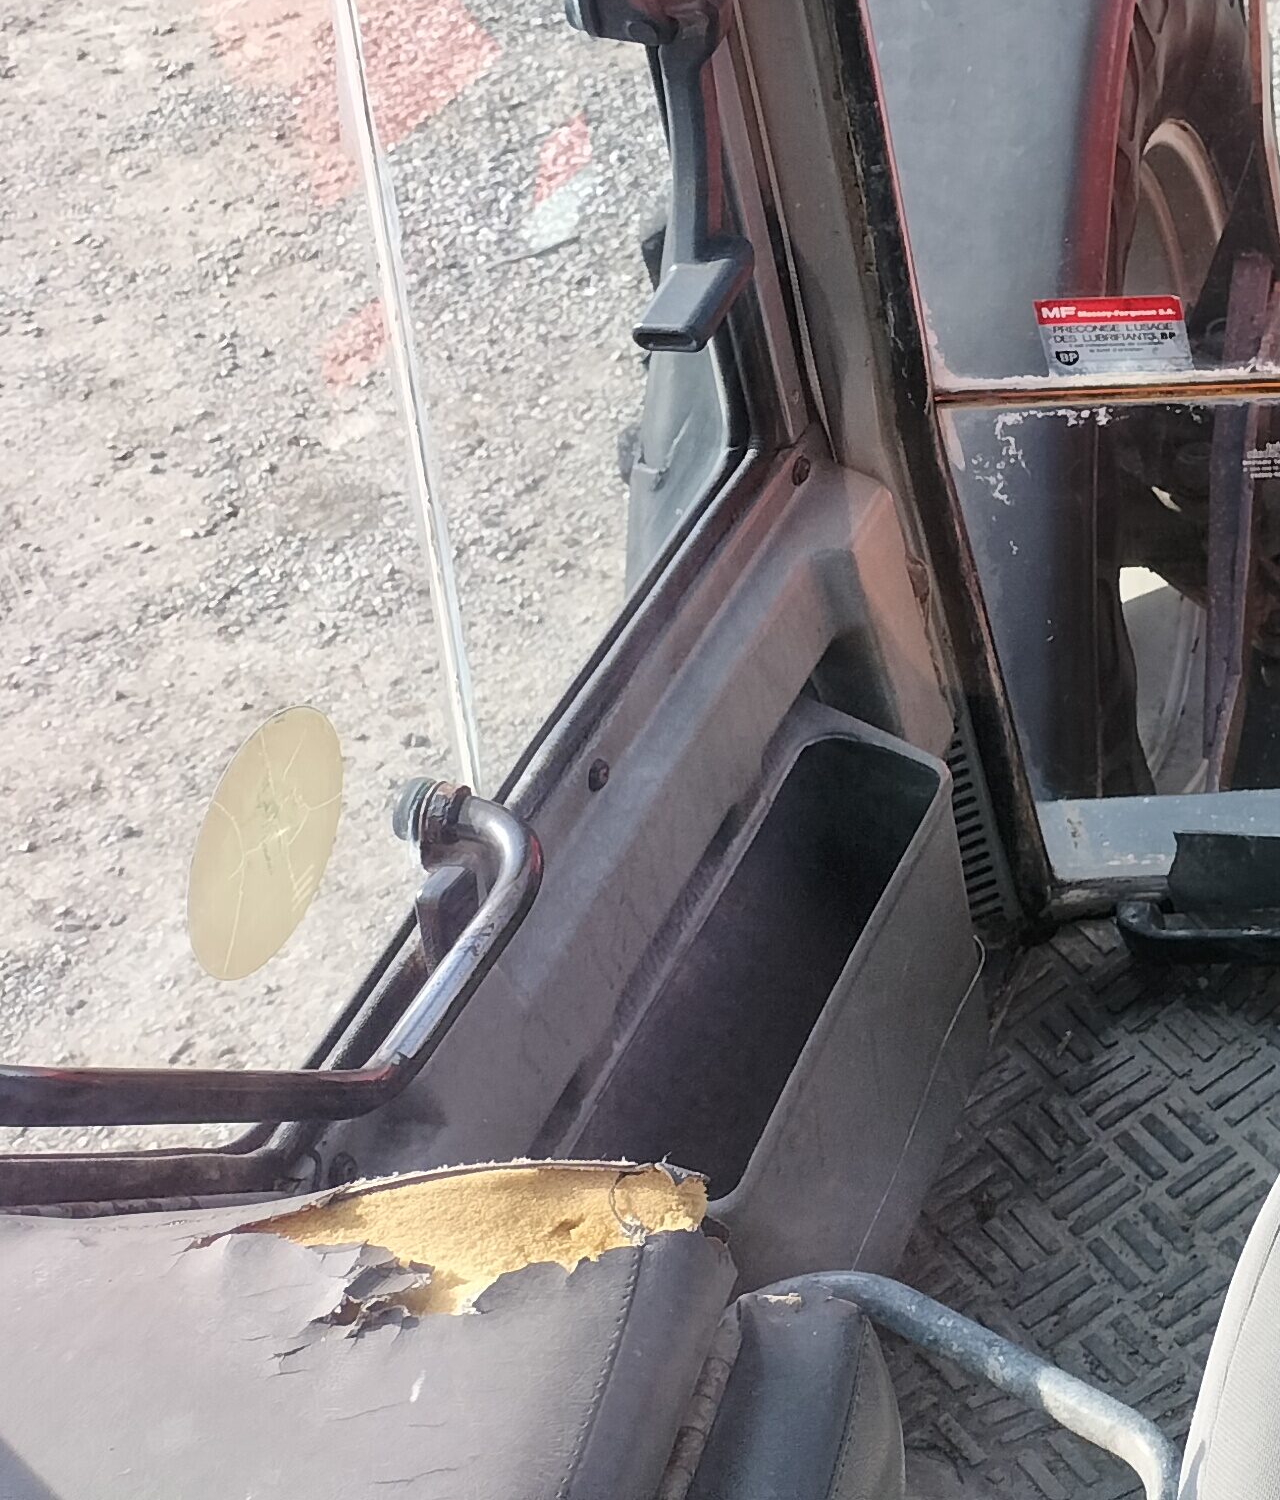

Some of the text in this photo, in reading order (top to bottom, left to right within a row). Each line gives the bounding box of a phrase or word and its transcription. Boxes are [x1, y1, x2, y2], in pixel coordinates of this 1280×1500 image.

[1041, 306, 1077, 319] MF
[1053, 334, 1077, 343] DES
[1060, 352, 1077, 362] BP
